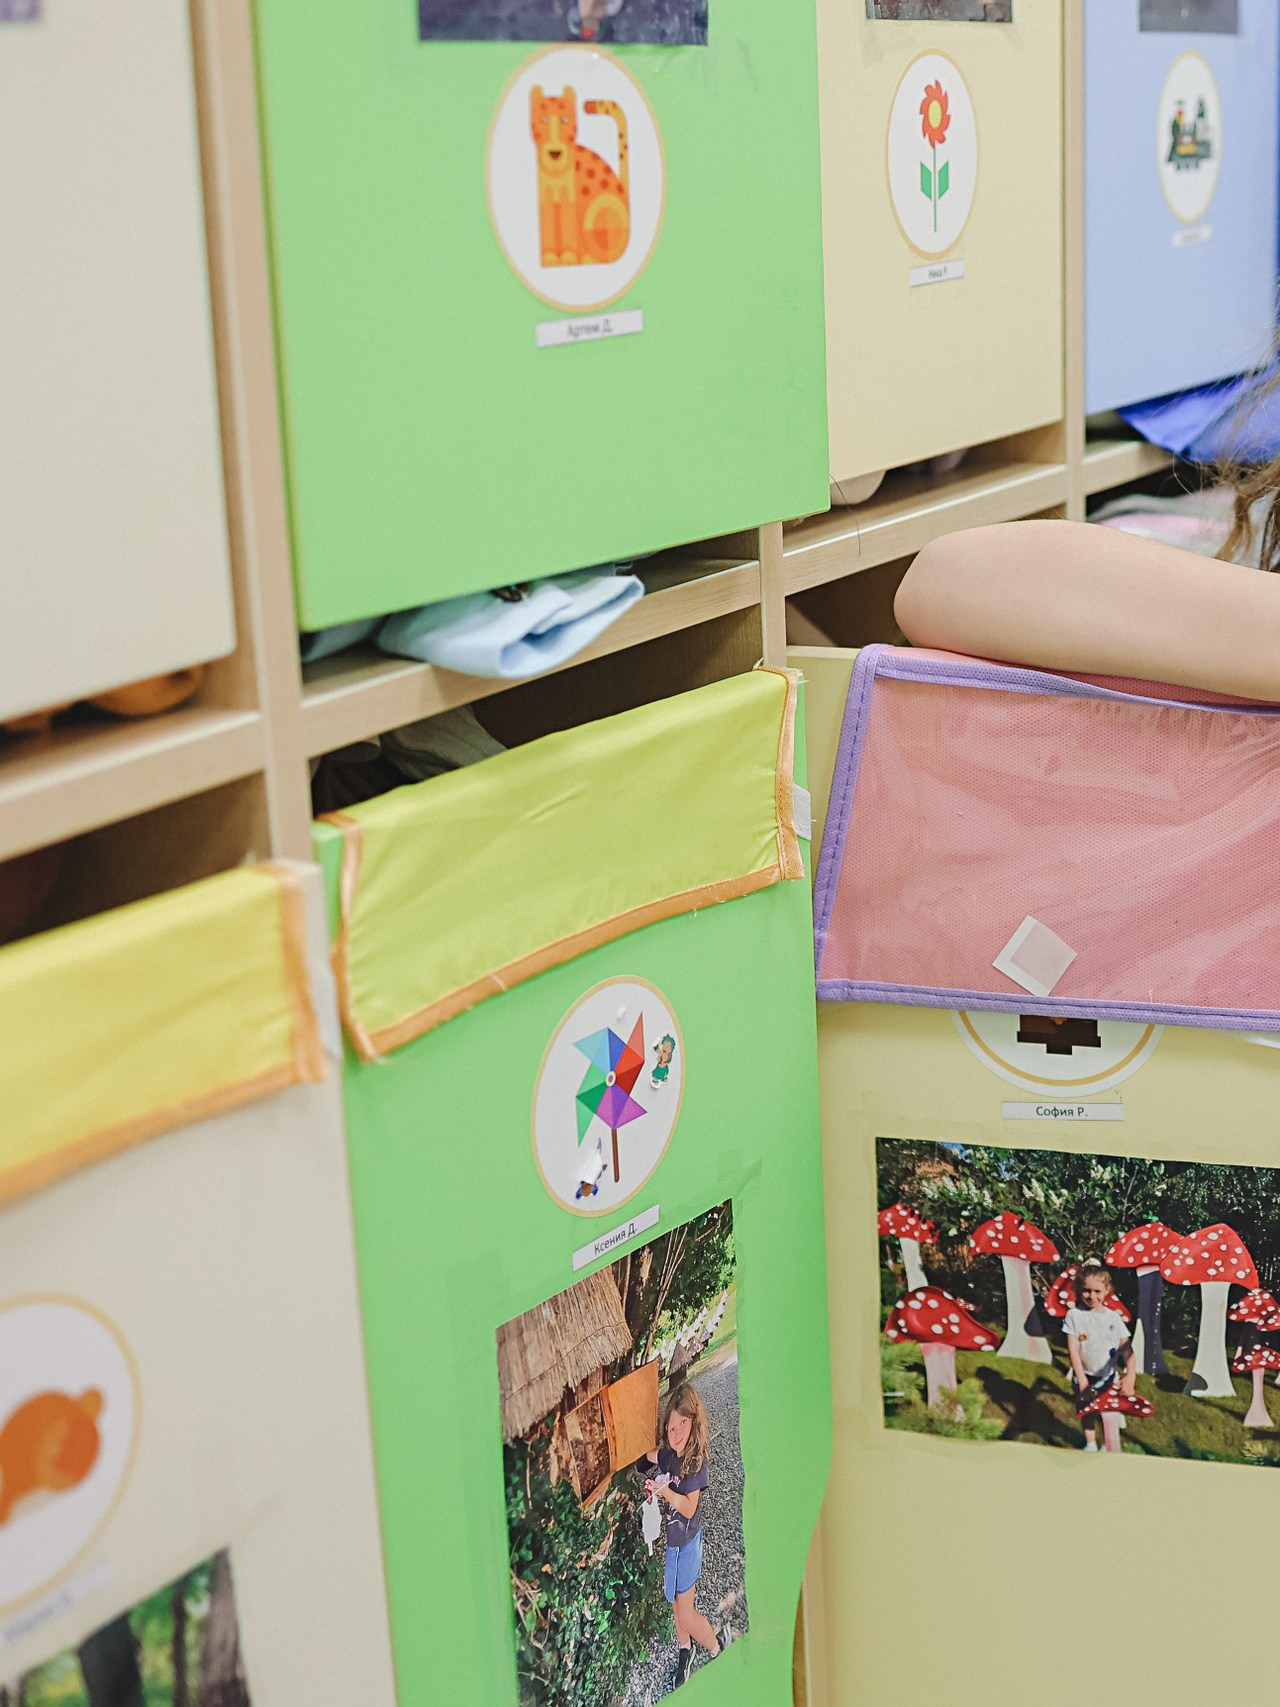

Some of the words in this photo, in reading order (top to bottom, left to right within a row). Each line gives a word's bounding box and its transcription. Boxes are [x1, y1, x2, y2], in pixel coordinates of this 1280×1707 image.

[1036, 1106, 1074, 1118] София
[1077, 1106, 1088, 1117] Р.
[594, 1229, 626, 1255] Ксения
[628, 1222, 638, 1239] Д.
